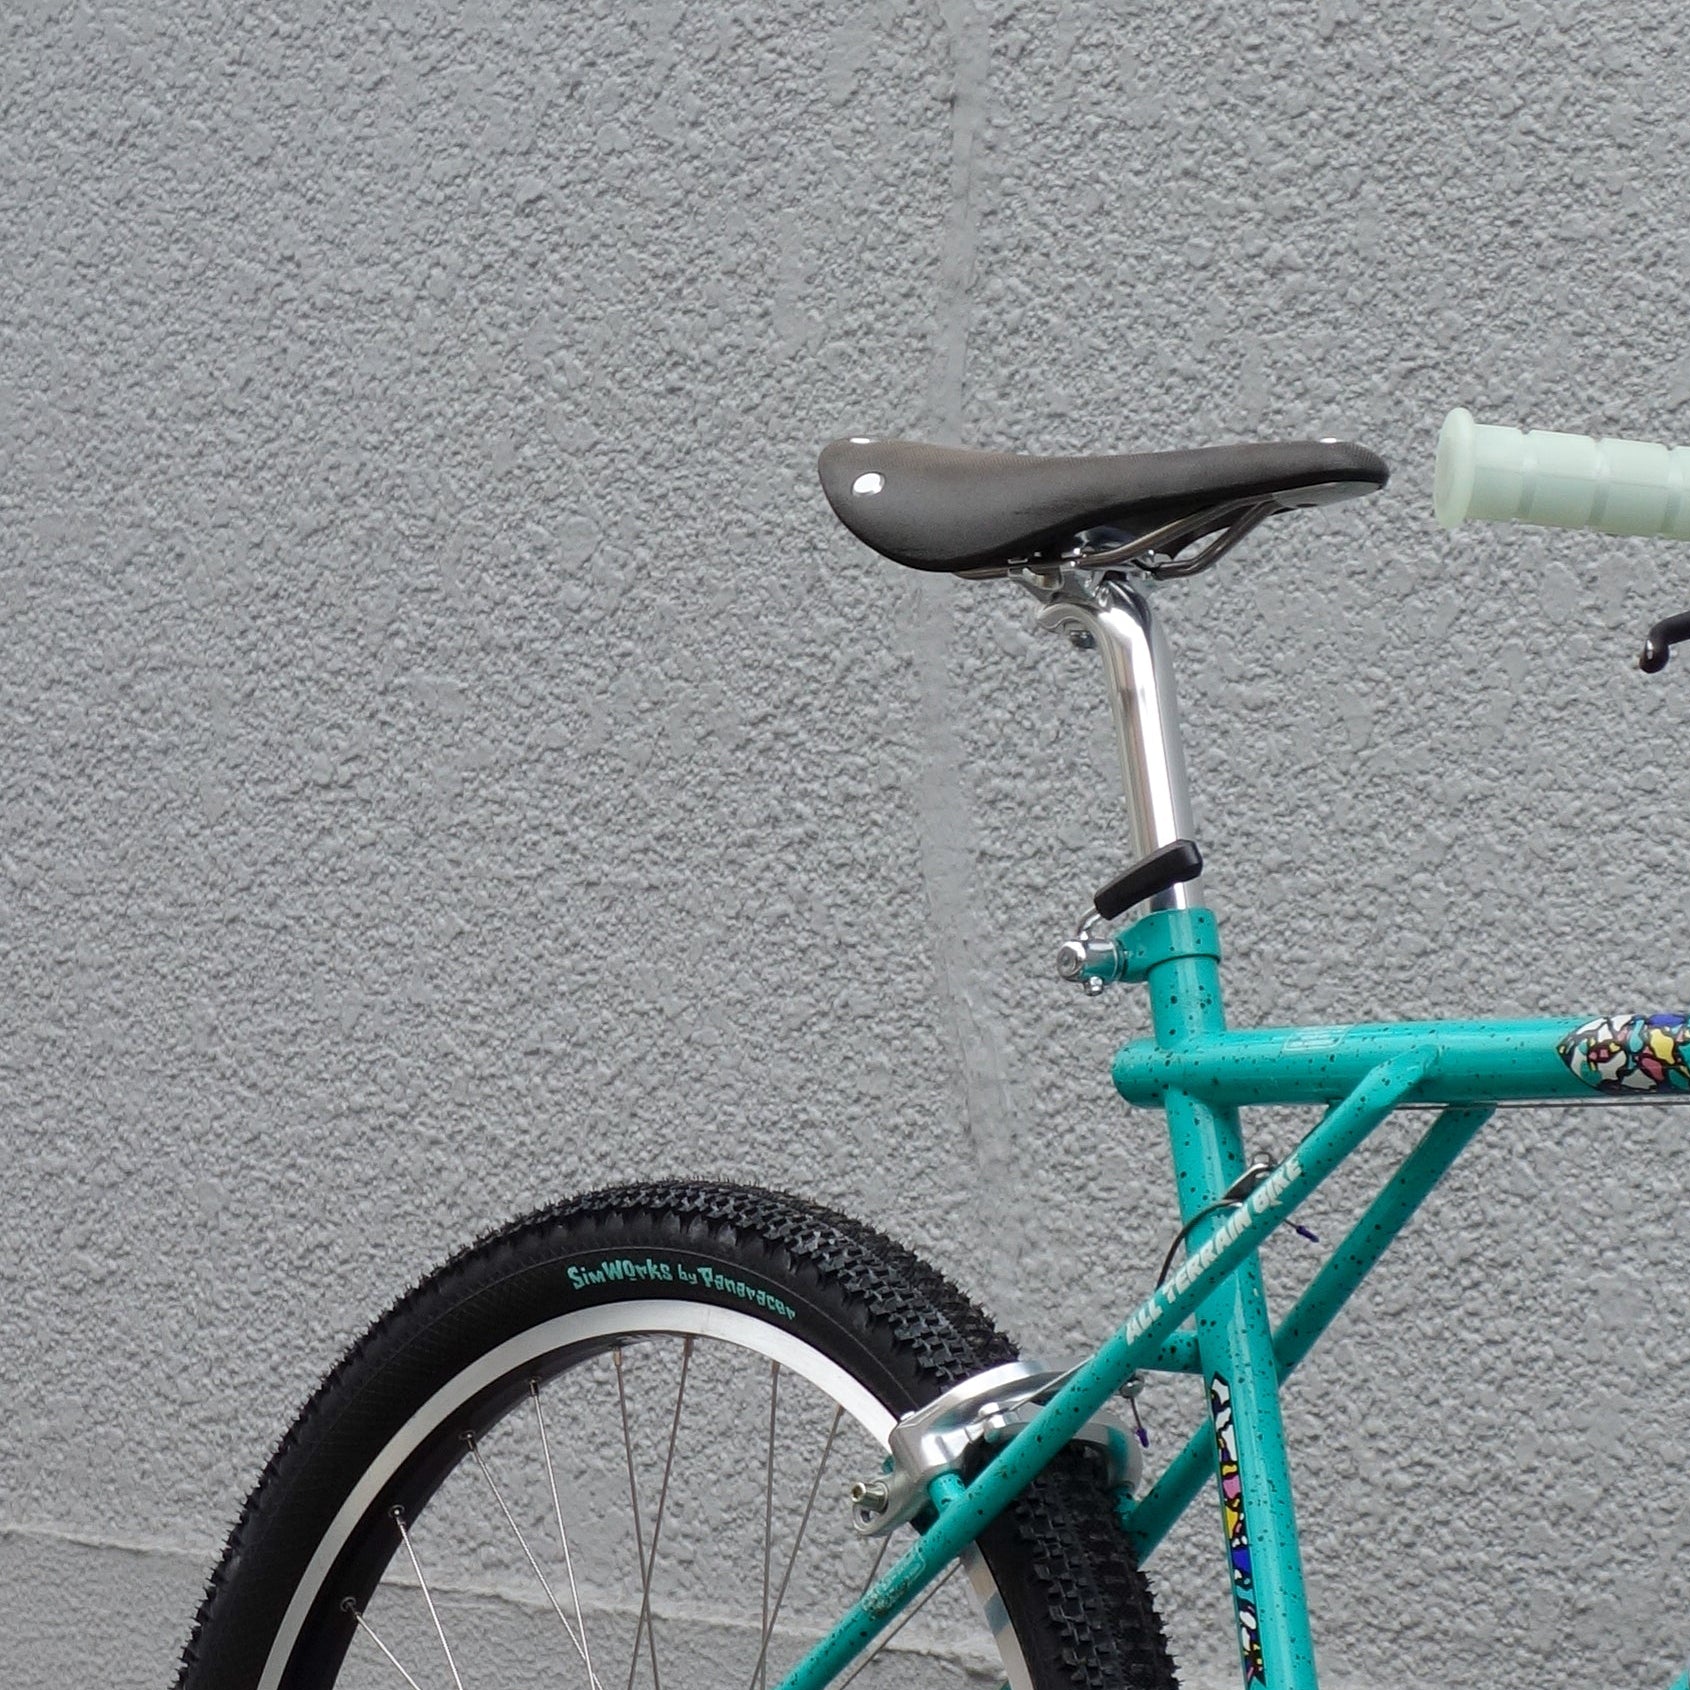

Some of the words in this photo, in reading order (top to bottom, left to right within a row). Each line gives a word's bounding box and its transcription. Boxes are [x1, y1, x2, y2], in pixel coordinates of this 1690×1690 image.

[1126, 1300, 1163, 1346] ALL
[1162, 1210, 1253, 1304] TERRAIN
[1252, 1155, 1302, 1214] BIKE
